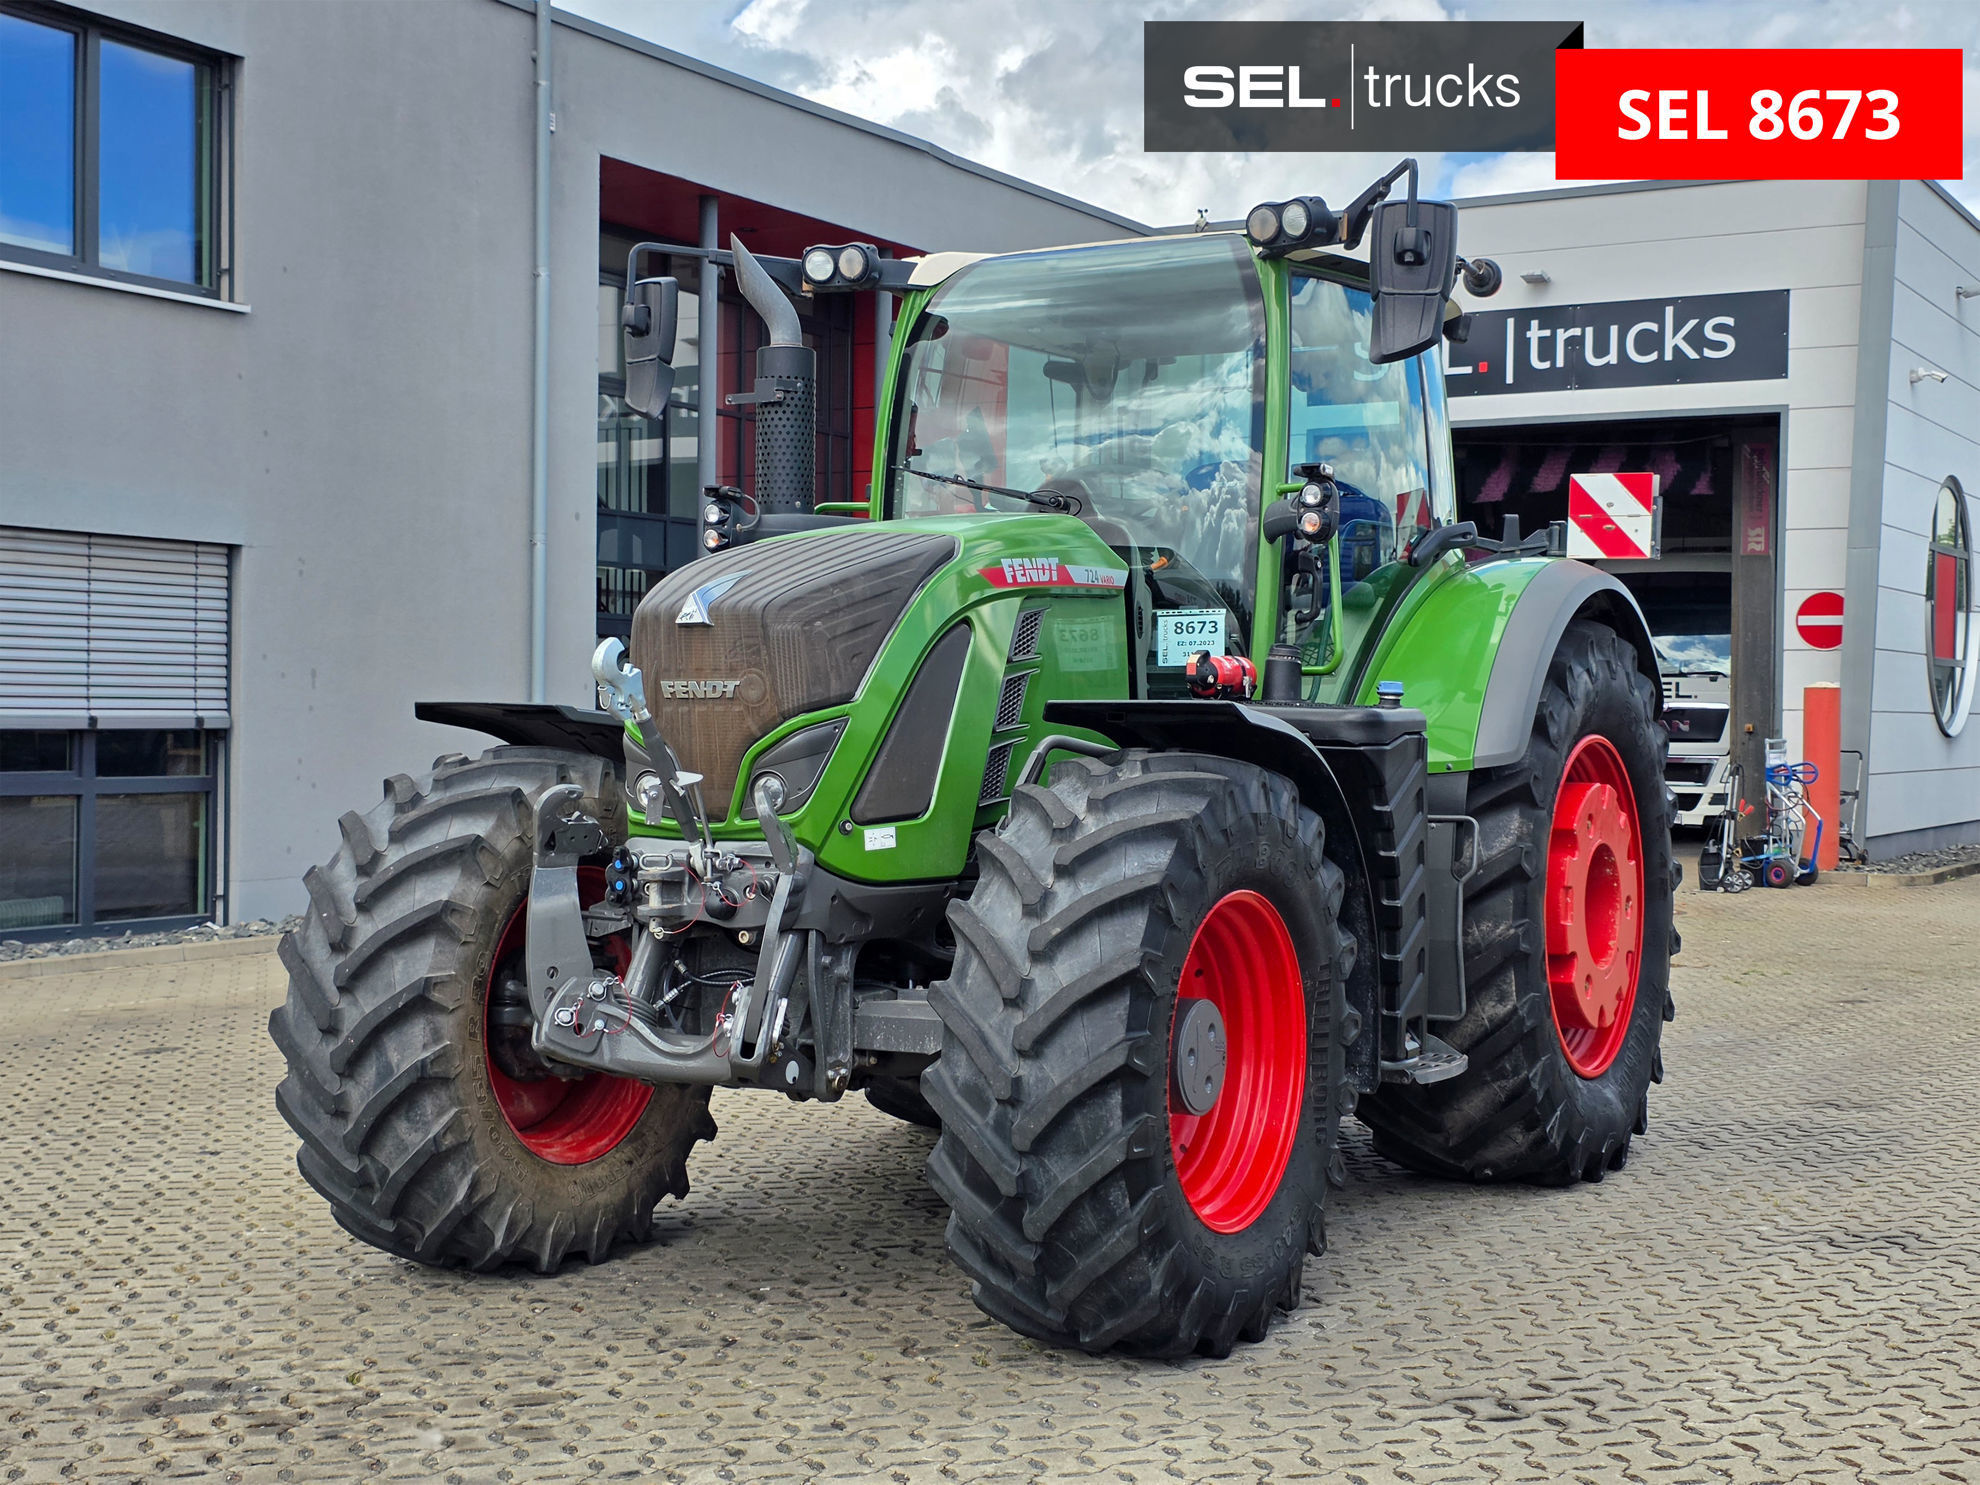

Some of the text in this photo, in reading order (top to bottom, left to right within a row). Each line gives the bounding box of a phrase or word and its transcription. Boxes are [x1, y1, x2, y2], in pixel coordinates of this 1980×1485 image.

[1526, 305, 1736, 370] trucks
[1001, 557, 1115, 585] FENDT 724 VARIO
[1174, 620, 1219, 635] 8673
[660, 680, 741, 699] FENDT
